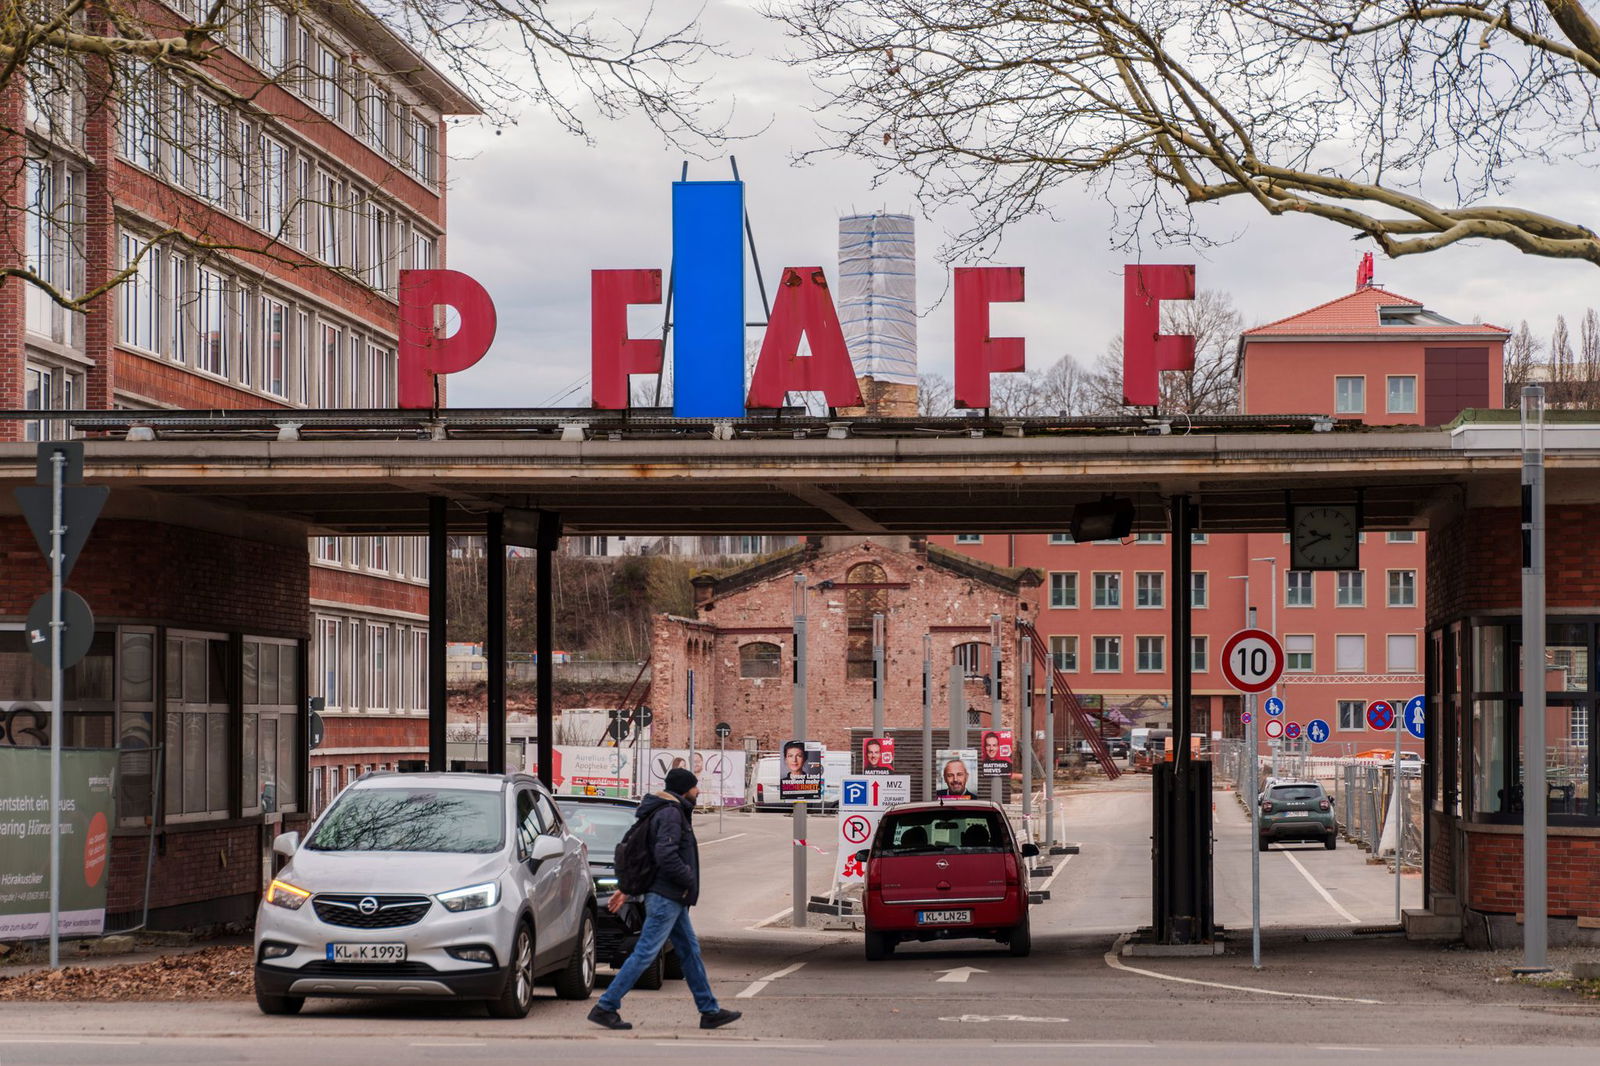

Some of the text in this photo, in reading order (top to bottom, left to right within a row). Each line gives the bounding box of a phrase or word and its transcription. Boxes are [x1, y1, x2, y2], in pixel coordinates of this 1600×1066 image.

[399, 264, 1195, 411] PFAFF
[1237, 648, 1267, 676] 10
[36, 795, 49, 811] ein
[925, 911, 938, 921] KL
[335, 945, 403, 959] KL K 1993
